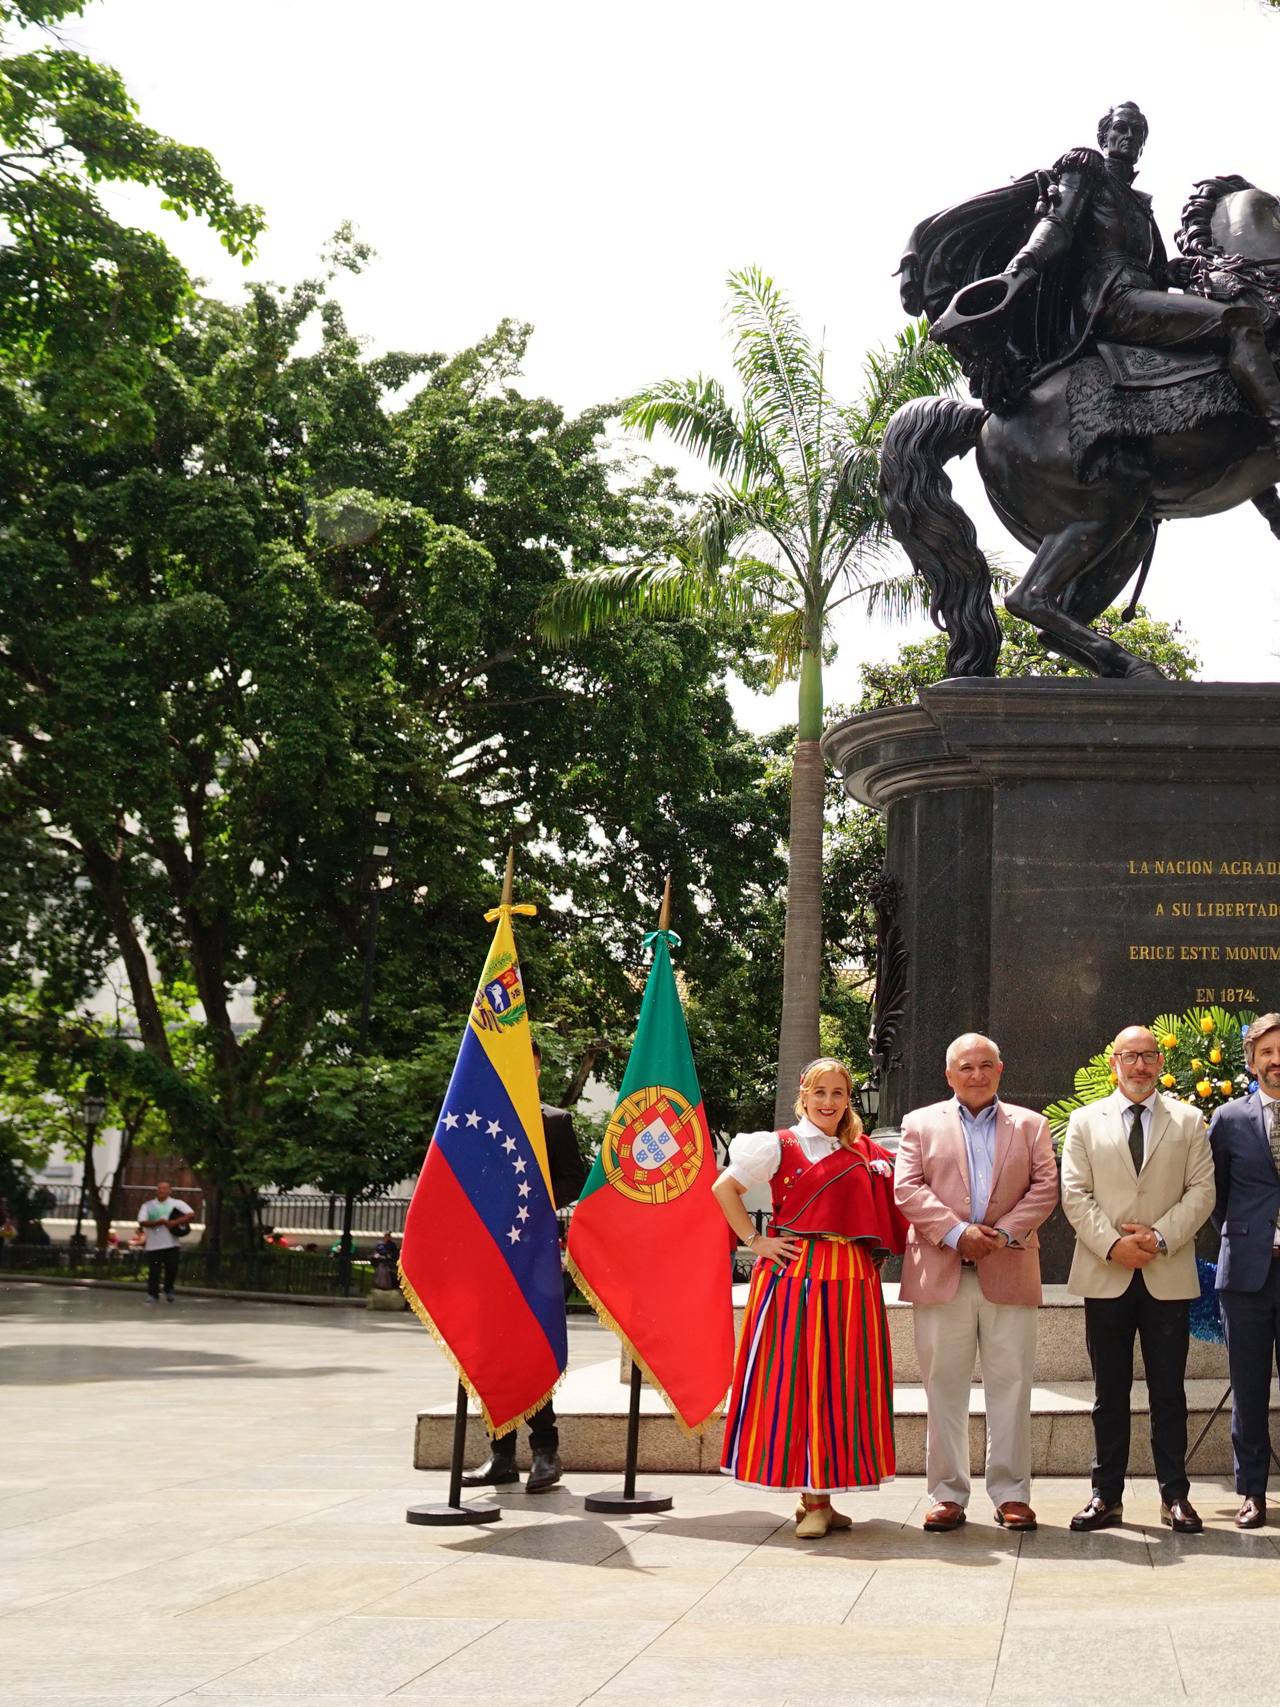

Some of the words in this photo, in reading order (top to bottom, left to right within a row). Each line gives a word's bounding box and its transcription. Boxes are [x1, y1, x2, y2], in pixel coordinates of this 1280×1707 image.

[1128, 860, 1149, 874] LA
[1154, 860, 1213, 875] NACION
[1155, 903, 1164, 917] A
[1171, 902, 1191, 917] SU
[1180, 946, 1220, 960] ESTE
[1195, 988, 1215, 1003] EN
